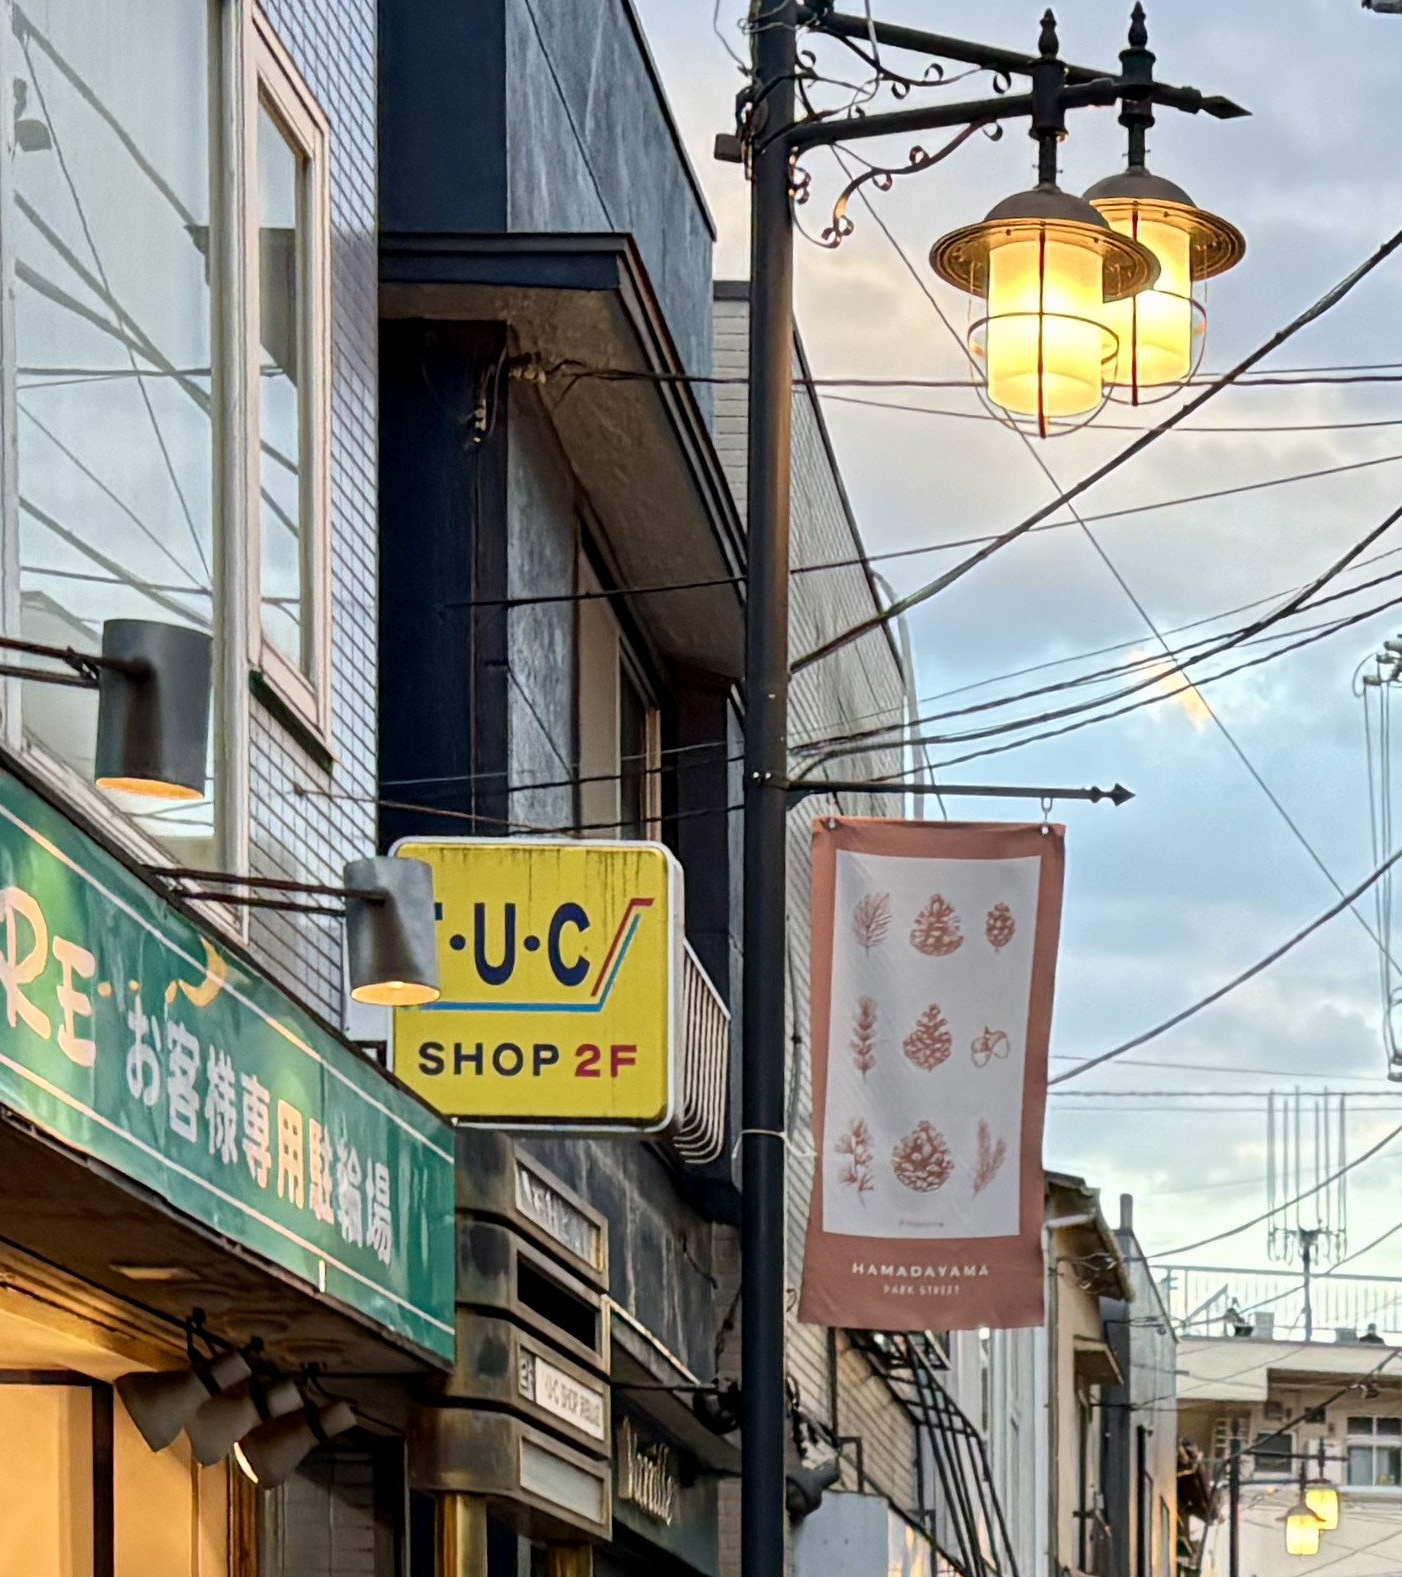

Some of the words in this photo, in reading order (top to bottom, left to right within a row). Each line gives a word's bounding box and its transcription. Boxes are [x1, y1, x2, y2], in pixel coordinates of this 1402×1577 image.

[418, 1041, 560, 1077] SHOP
[574, 1043, 637, 1079] 2F
[126, 994, 393, 1267] お客様専用駐輪場
[851, 1262, 989, 1279] HAMADAYAMA
